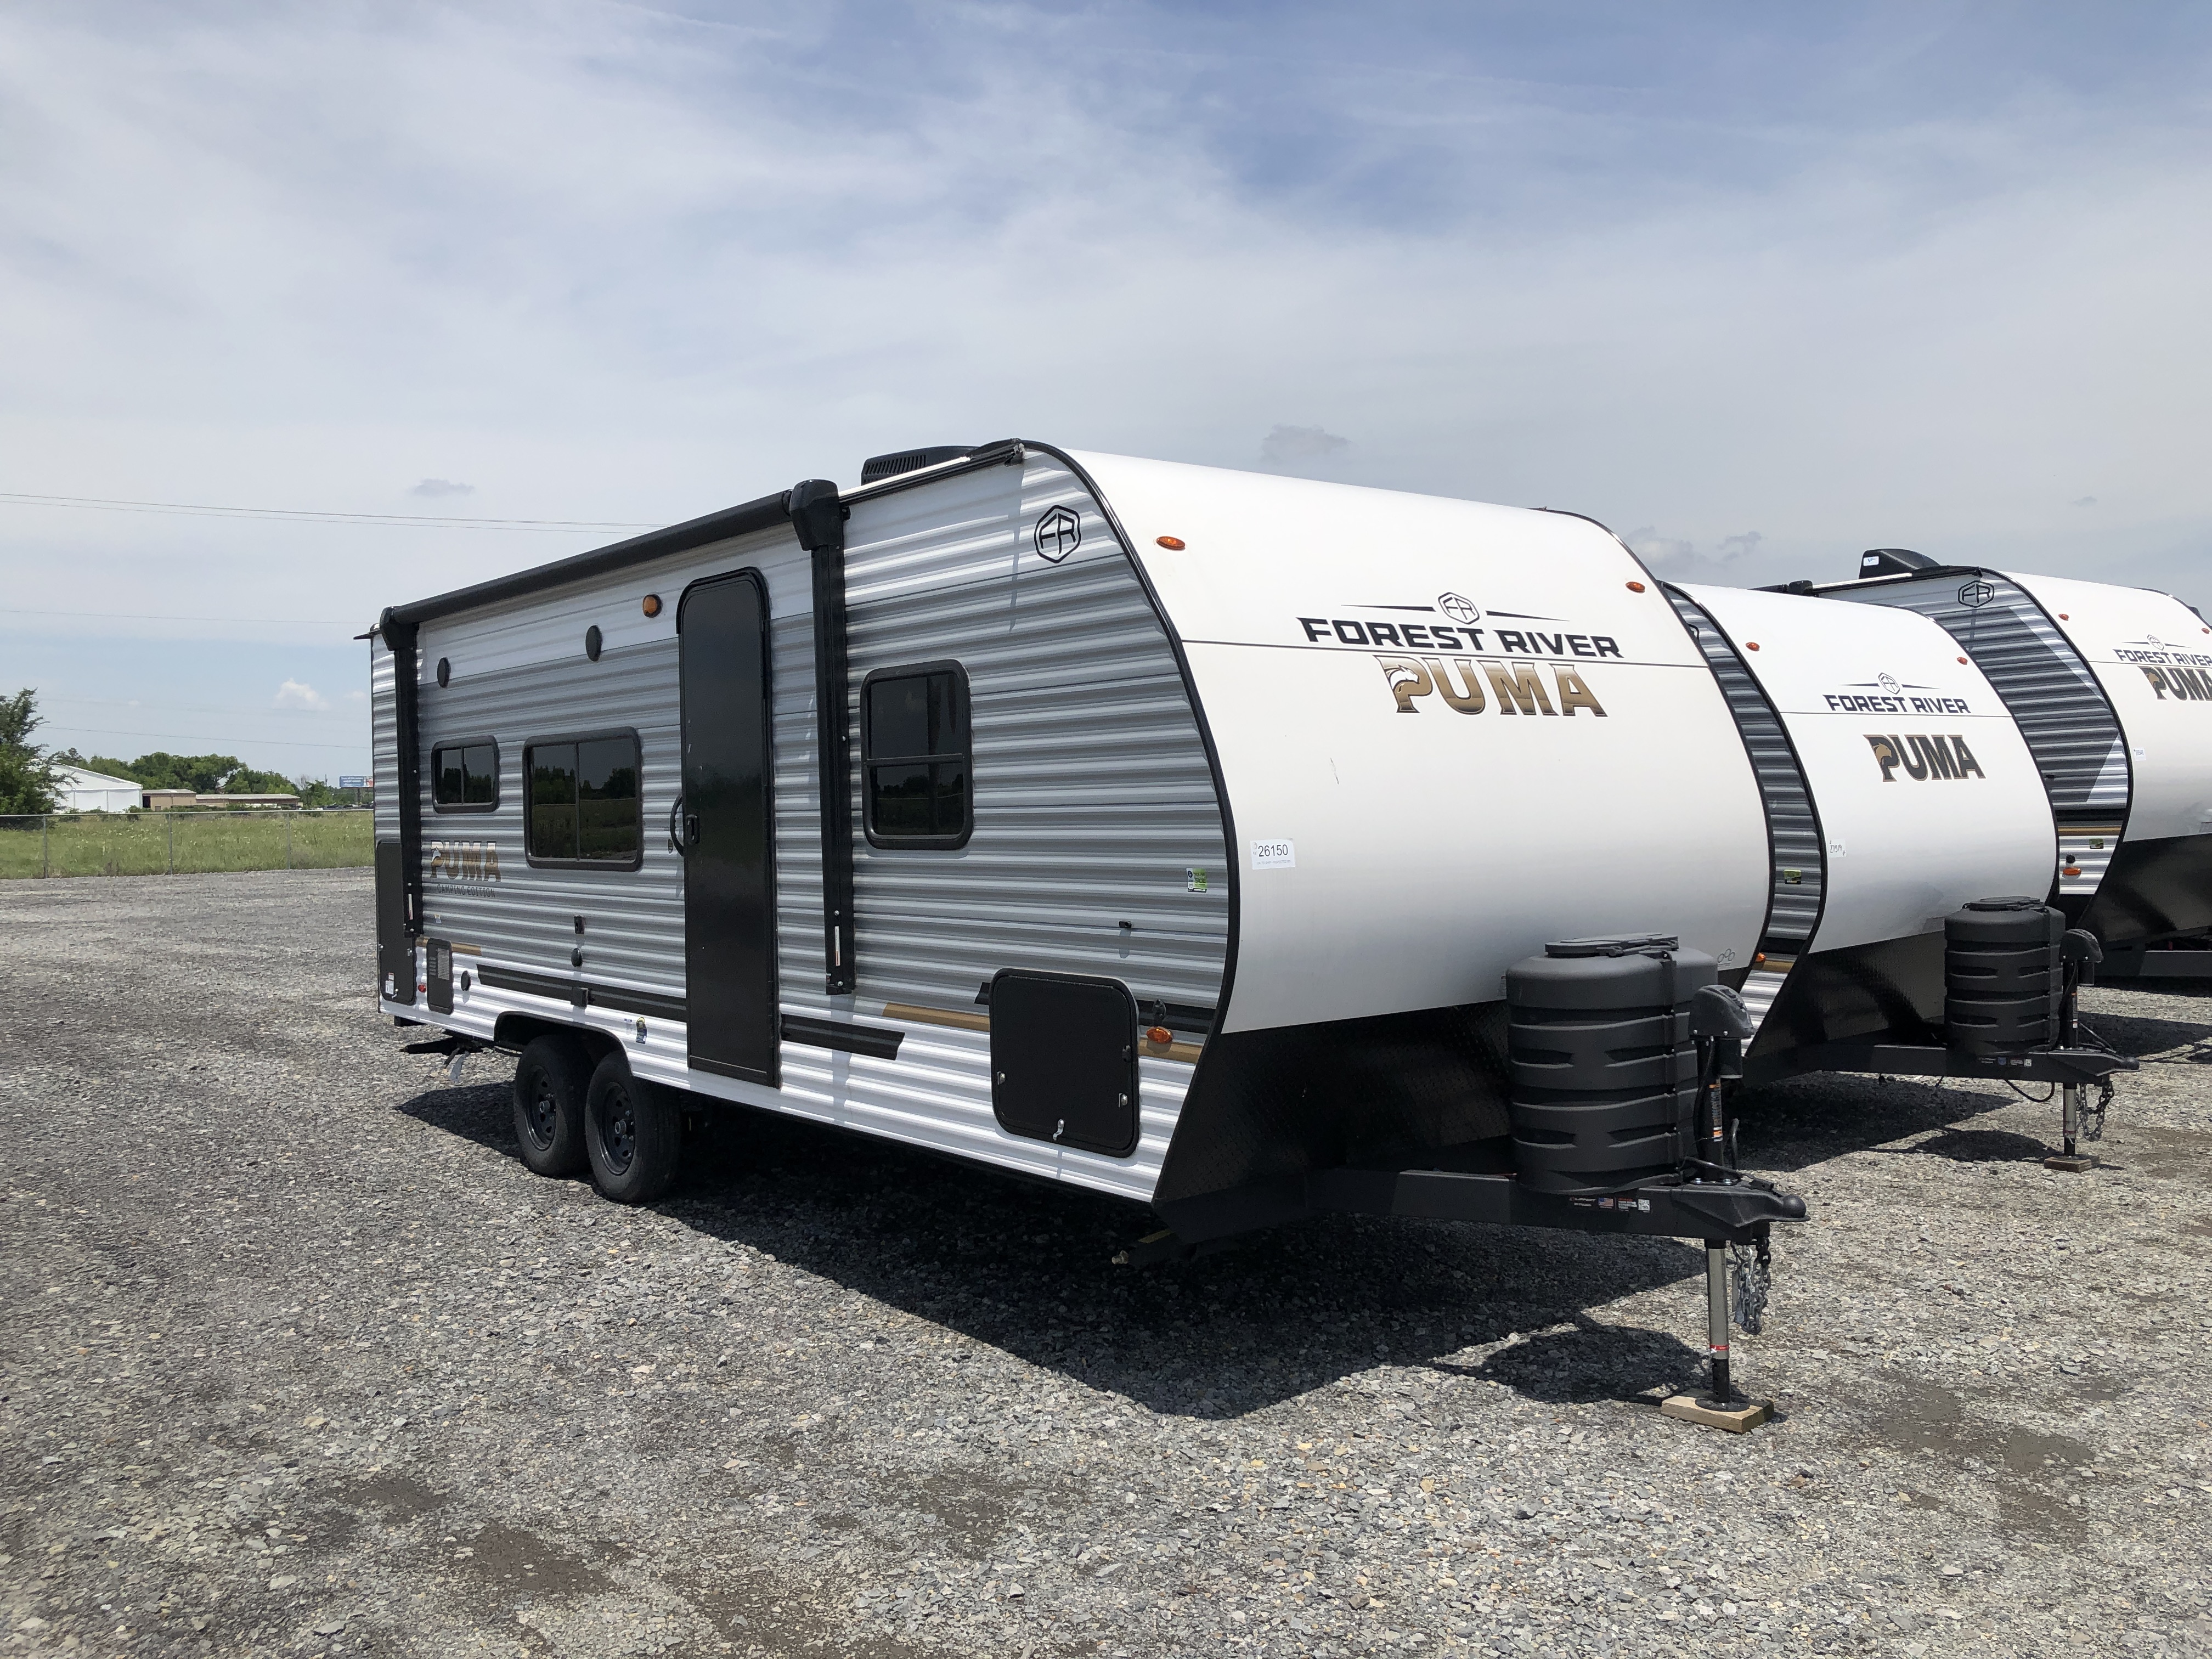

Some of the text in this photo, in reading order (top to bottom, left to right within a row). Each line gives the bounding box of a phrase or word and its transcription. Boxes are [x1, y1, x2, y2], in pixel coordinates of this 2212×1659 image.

[1295, 617, 1624, 658] FOREST RIVER
[2112, 649, 2212, 666] FOREST RIVER
[1373, 655, 1609, 717] PUMA
[1822, 695, 1972, 714] FOREST RIVER
[1863, 734, 1987, 782] PUMA
[430, 840, 501, 882] PUMA
[1258, 844, 1288, 857] 26150
[437, 884, 495, 898] CAMPING EDITION
